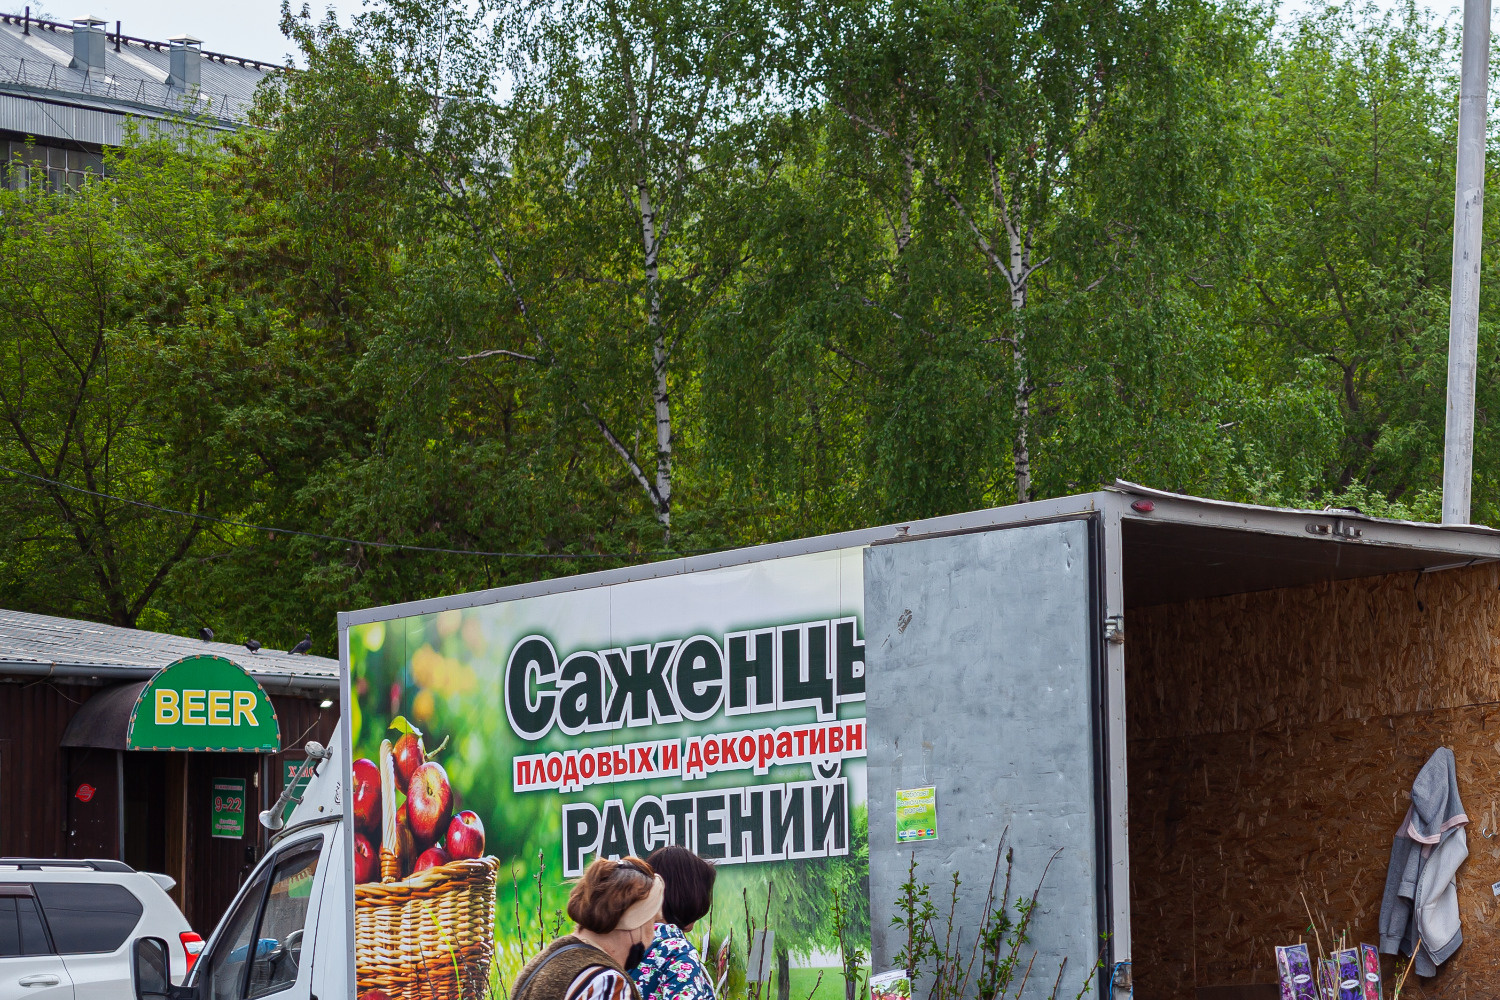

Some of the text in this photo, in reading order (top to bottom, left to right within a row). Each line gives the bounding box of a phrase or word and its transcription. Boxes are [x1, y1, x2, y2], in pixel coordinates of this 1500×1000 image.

[154, 689, 260, 727] BEER
[515, 722, 867, 787] плодовых и декоративн
[214, 796, 242, 814] 9-22
[564, 760, 848, 874] РАСТЕНИЙ
